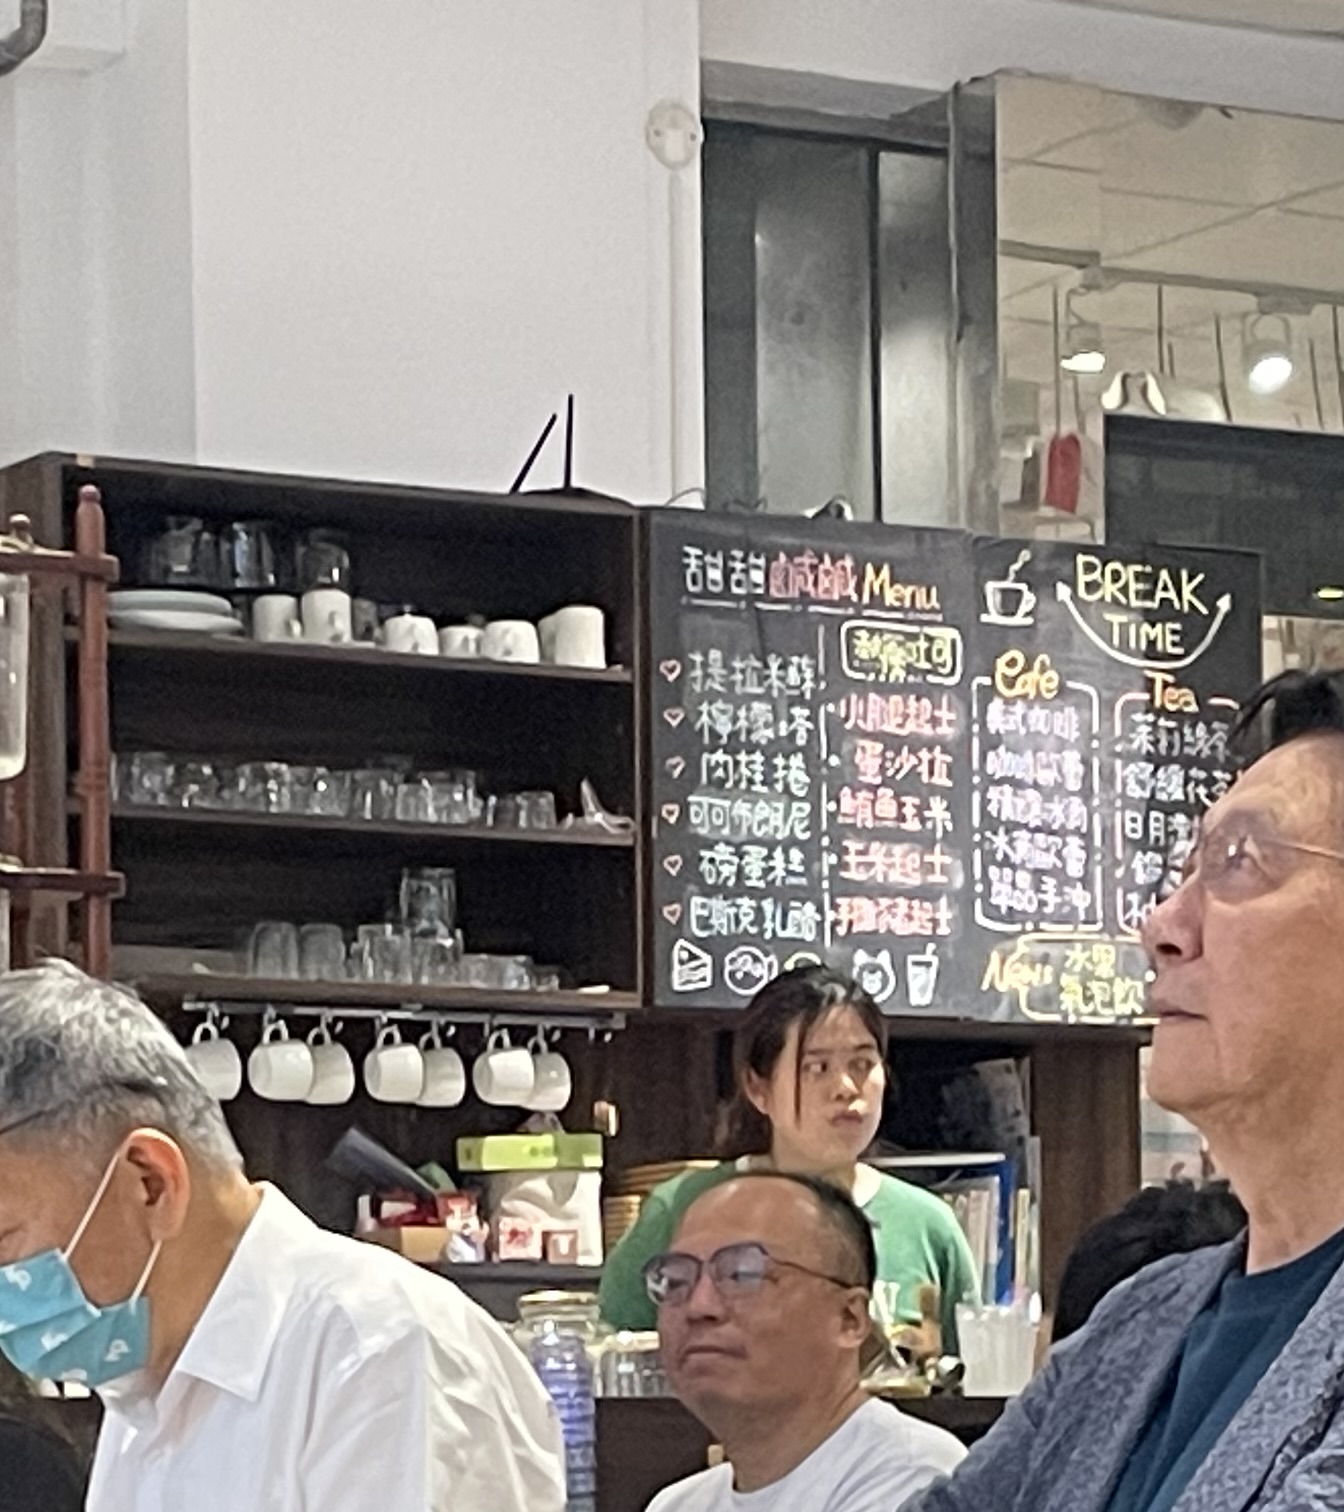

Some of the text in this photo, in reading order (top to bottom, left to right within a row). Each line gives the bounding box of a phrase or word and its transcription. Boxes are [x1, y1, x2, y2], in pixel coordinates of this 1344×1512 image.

[862, 562, 940, 609] Menu
[1075, 552, 1209, 615] BREAK
[1105, 614, 1185, 656] TIME
[994, 649, 1060, 699] Cafe
[1143, 669, 1199, 713] Tea
[854, 739, 954, 788] 蛋沙拉
[698, 842, 809, 888] 磅蛋糕
